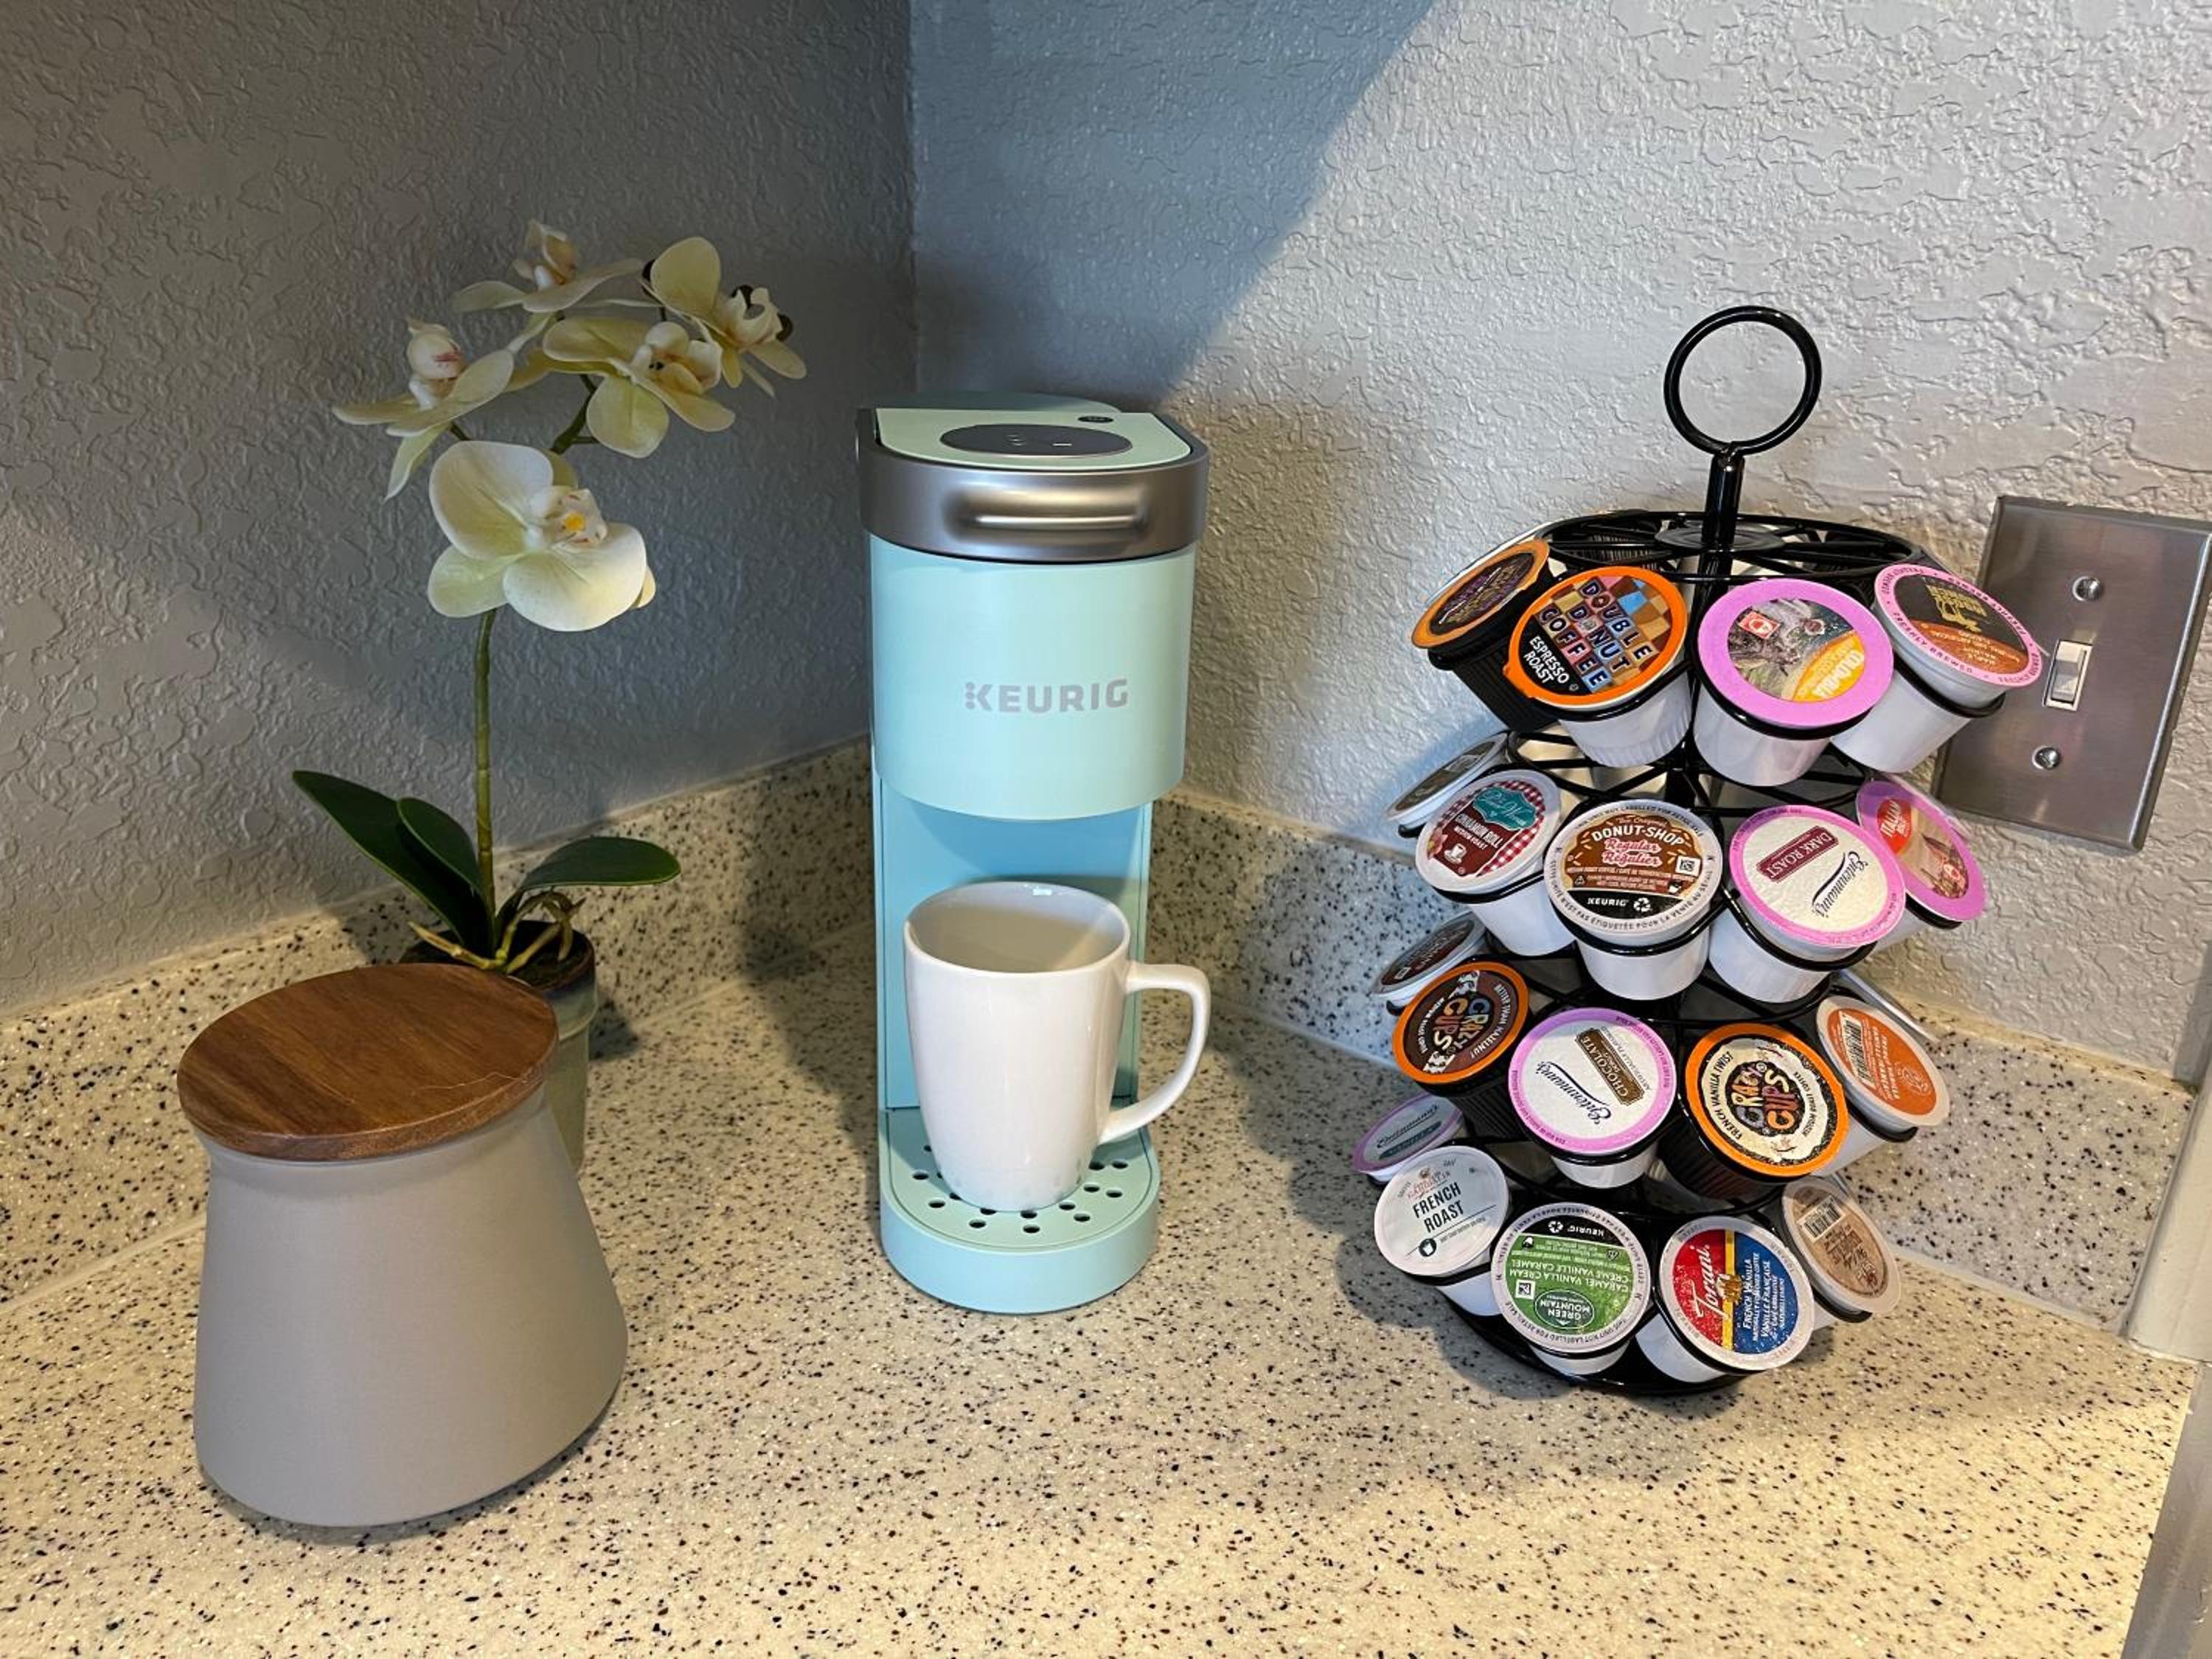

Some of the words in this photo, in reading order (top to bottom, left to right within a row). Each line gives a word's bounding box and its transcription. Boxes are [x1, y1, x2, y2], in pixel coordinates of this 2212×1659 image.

[1580, 580, 1652, 661] DOUBLE
[1539, 605, 1609, 687] COFFEE
[1893, 612, 1927, 646] FRESHLY
[1930, 647, 1973, 673] BREWED
[1523, 650, 1554, 685] ROAST
[1528, 636, 1571, 685] ESPRESSO
[965, 679, 1127, 713] KEURIG
[1483, 830, 1503, 848] ROLL
[1605, 838, 1663, 853] Regular
[1798, 831, 1832, 855] DARK
[1765, 848, 1803, 878] ROAST
[1812, 849, 1868, 918] Entenmann's
[1574, 910, 1590, 922] PAS
[1588, 914, 1633, 933] ÉTIQUETÉE
[1635, 919, 1660, 929] POUR
[1669, 900, 1694, 918] VENTE
[1587, 897, 1625, 906] KEURIG
[1425, 998, 1443, 1019] MEDIUM
[1494, 984, 1510, 1004] BETTER
[1434, 997, 1468, 1051] CUPS
[1453, 998, 1492, 1049] CRAZY
[1500, 1006, 1509, 1025] THAN
[1470, 1027, 1503, 1059] HAZELNUT
[1580, 1035, 1629, 1098] CHOCOLATE
[1714, 1050, 1733, 1072] TWIST
[1537, 1061, 1610, 1125] Entenmann's
[1710, 1074, 1719, 1107] VANILLA
[1731, 1066, 1767, 1130] CRAZY
[1793, 1071, 1810, 1092] COFFEE
[1761, 1068, 1798, 1130] CUPS
[1806, 1092, 1817, 1113] ROAST
[1715, 1107, 1742, 1140] FRENCH
[1801, 1113, 1817, 1136] MEDIUM
[1413, 1182, 1461, 1218] FRENCH
[1425, 1200, 1463, 1233] ROAST
[1570, 1225, 1603, 1236] KEURIG
[1509, 1268, 1541, 1280] CREAM
[1512, 1259, 1554, 1271] CARAMEL
[1543, 1273, 1582, 1285] VANILLA
[1556, 1265, 1593, 1277] VANILLE
[1690, 1245, 1730, 1318] Torani
[1742, 1259, 1752, 1293] VANILLA
[1584, 1278, 1629, 1293] CARAMEL
[1541, 1299, 1590, 1313] MOUNTAIN
[1548, 1308, 1582, 1321] GREEN
[1742, 1296, 1751, 1329] FRENCH
[1761, 1304, 1770, 1337] VANILLE
